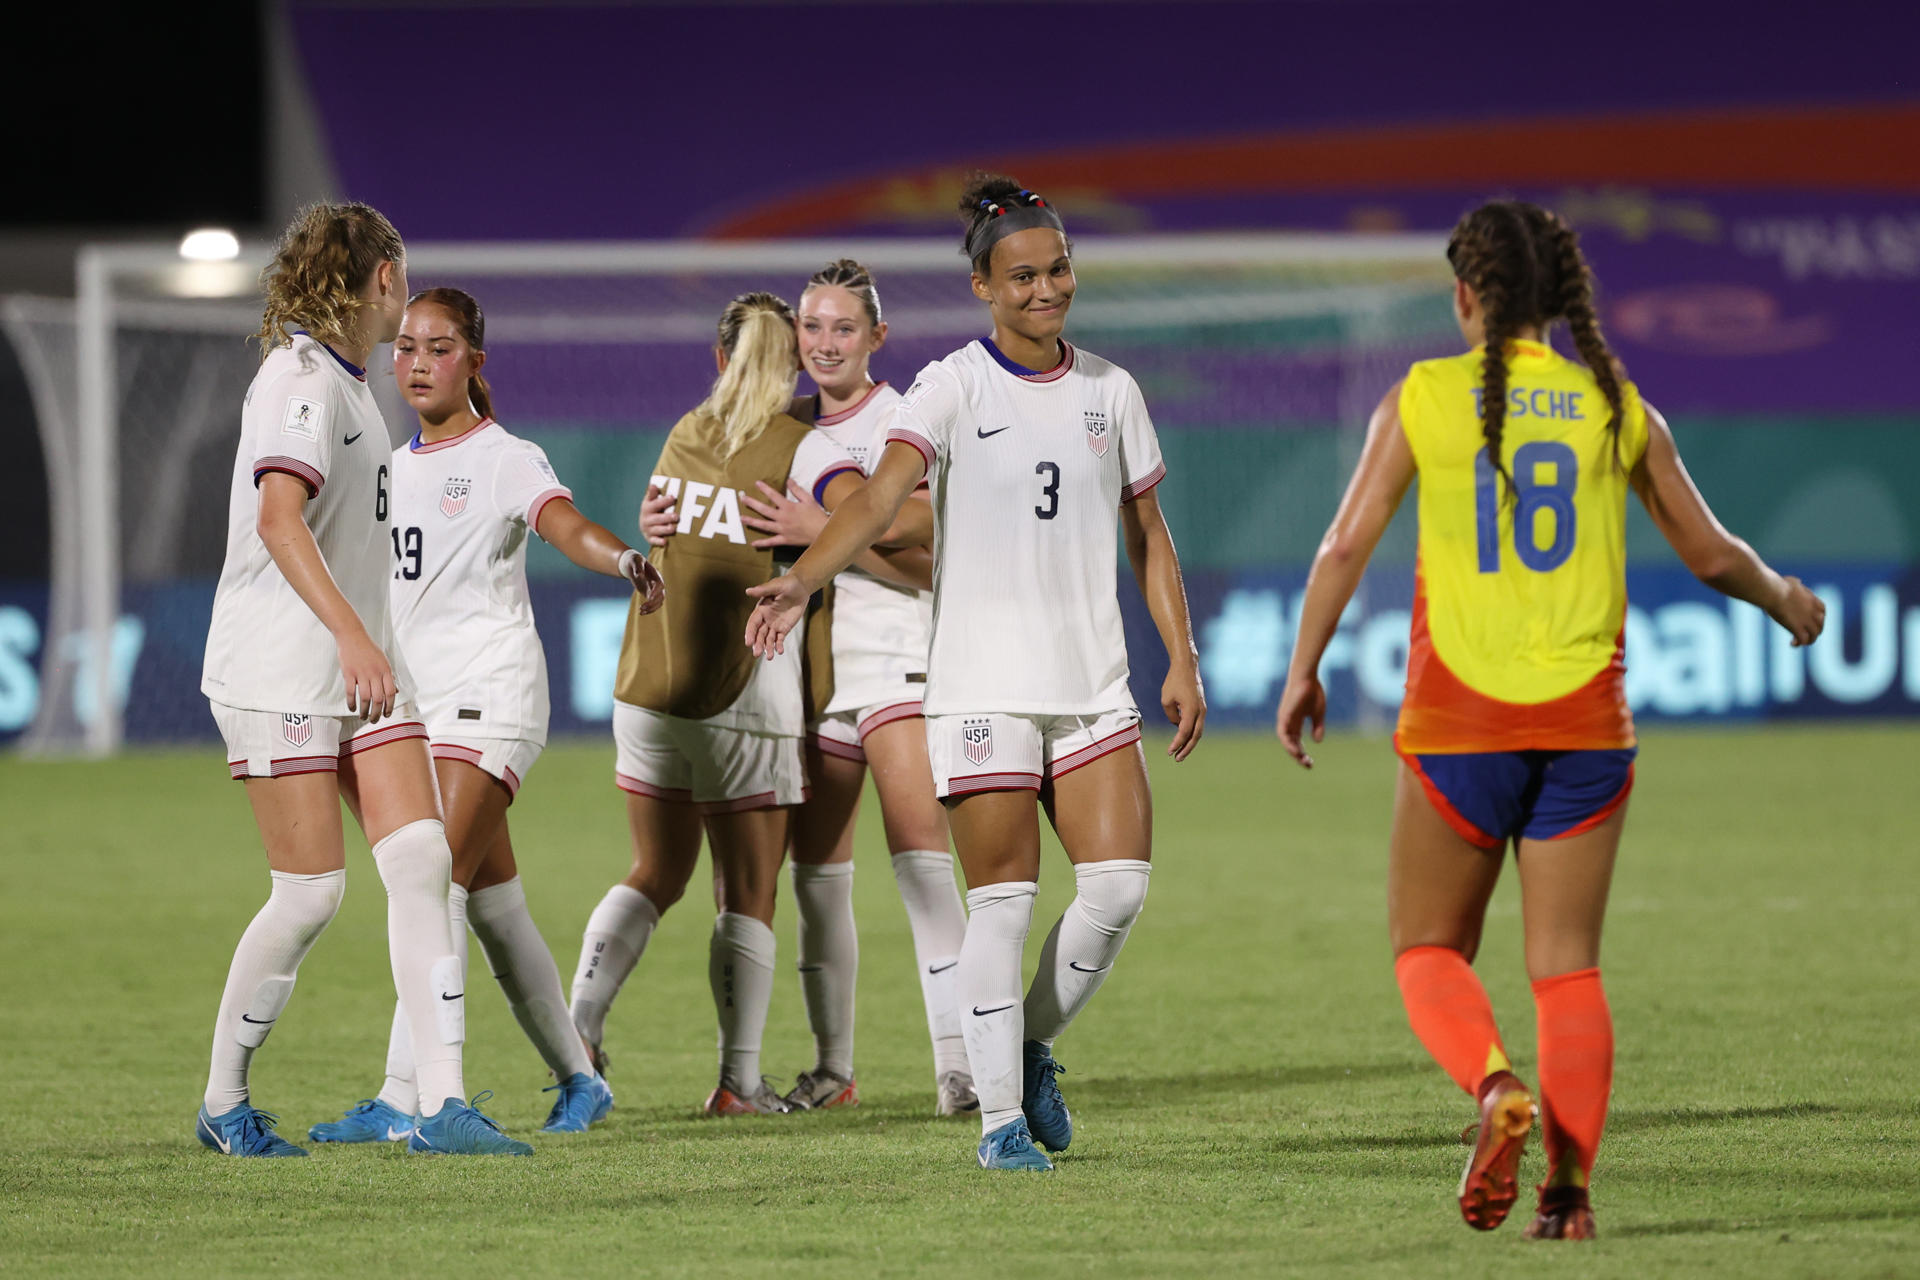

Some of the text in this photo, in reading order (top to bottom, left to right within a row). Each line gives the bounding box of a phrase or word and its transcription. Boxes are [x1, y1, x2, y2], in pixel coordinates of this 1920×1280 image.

[1470, 387, 1586, 421] TSCHE
[1087, 421, 1106, 436] USA
[376, 465, 388, 521] 6
[446, 485, 468, 499] USA
[1035, 461, 1060, 520] 3
[1474, 440, 1579, 574] 18
[391, 527, 423, 580] 19
[965, 728, 989, 744] USA
[585, 941, 605, 980] USA
